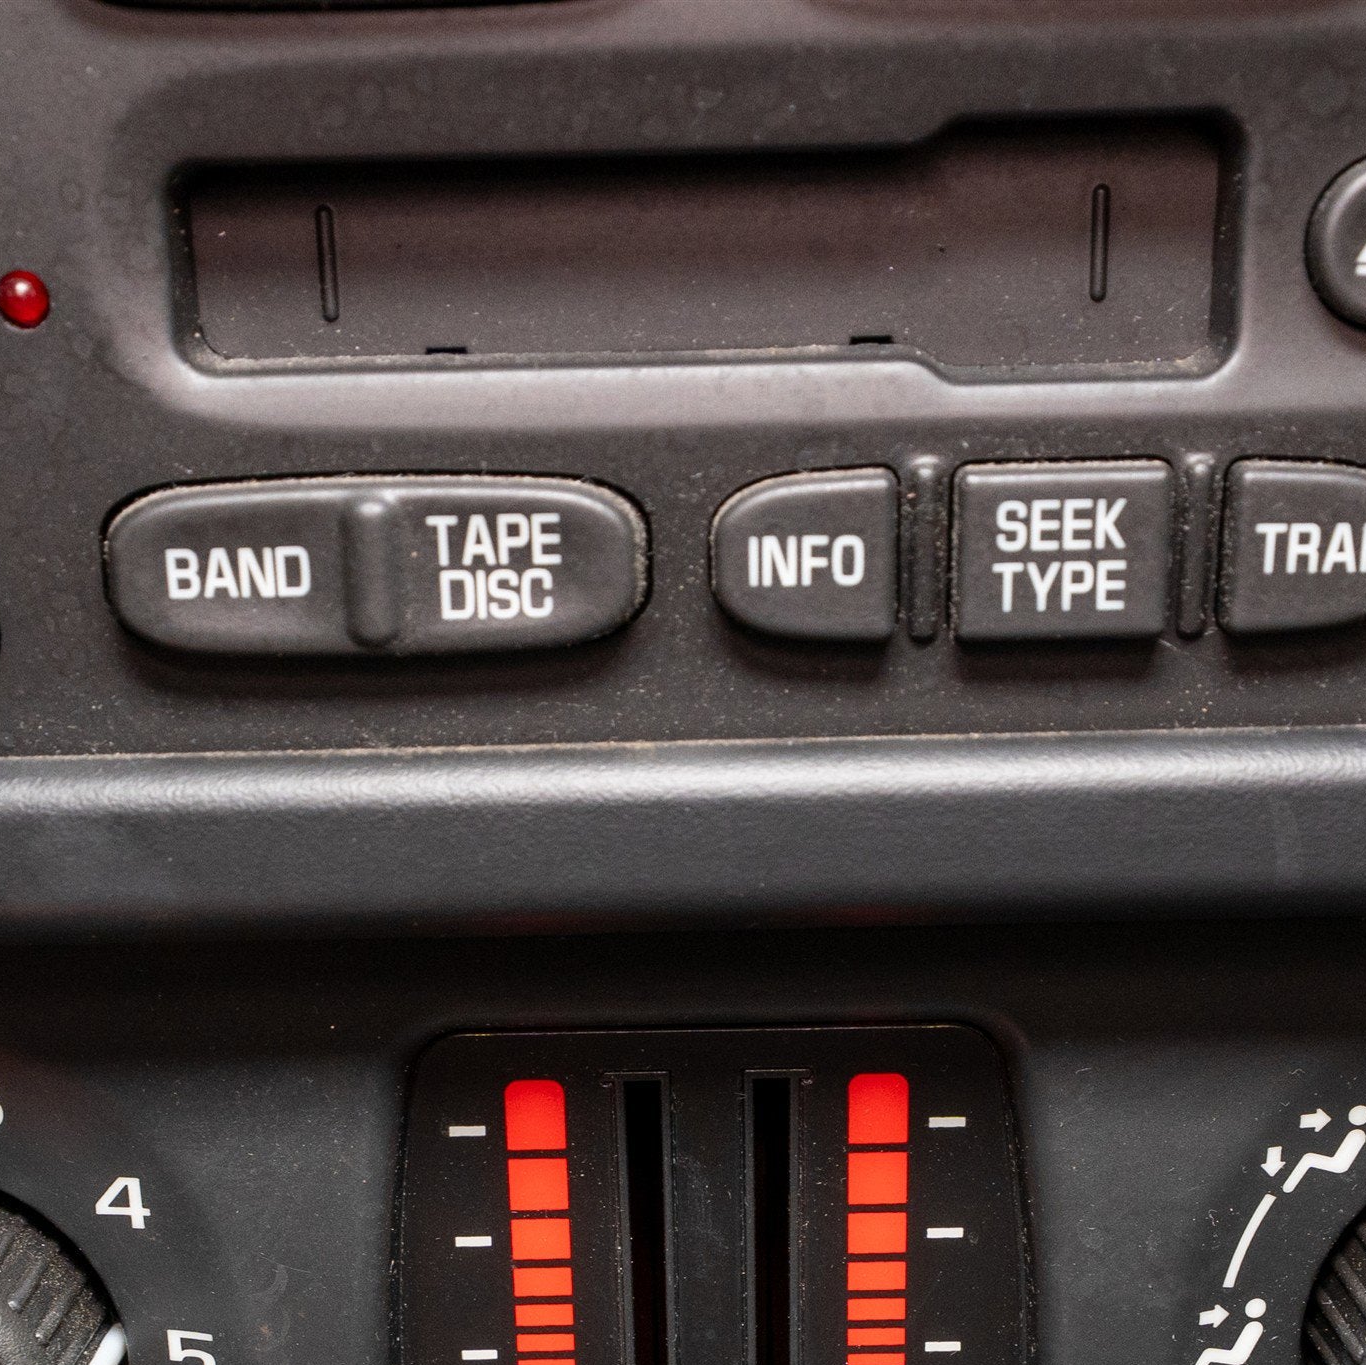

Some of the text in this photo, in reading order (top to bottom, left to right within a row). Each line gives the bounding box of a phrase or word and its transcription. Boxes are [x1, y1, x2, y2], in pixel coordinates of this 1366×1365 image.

[425, 512, 562, 567] TAPE
[995, 498, 1127, 552] SEEK
[164, 545, 312, 600] BAND
[747, 534, 866, 588] INFO
[992, 558, 1127, 613] TYPE
[439, 568, 555, 621] DISC
[95, 1176, 152, 1231] 4
